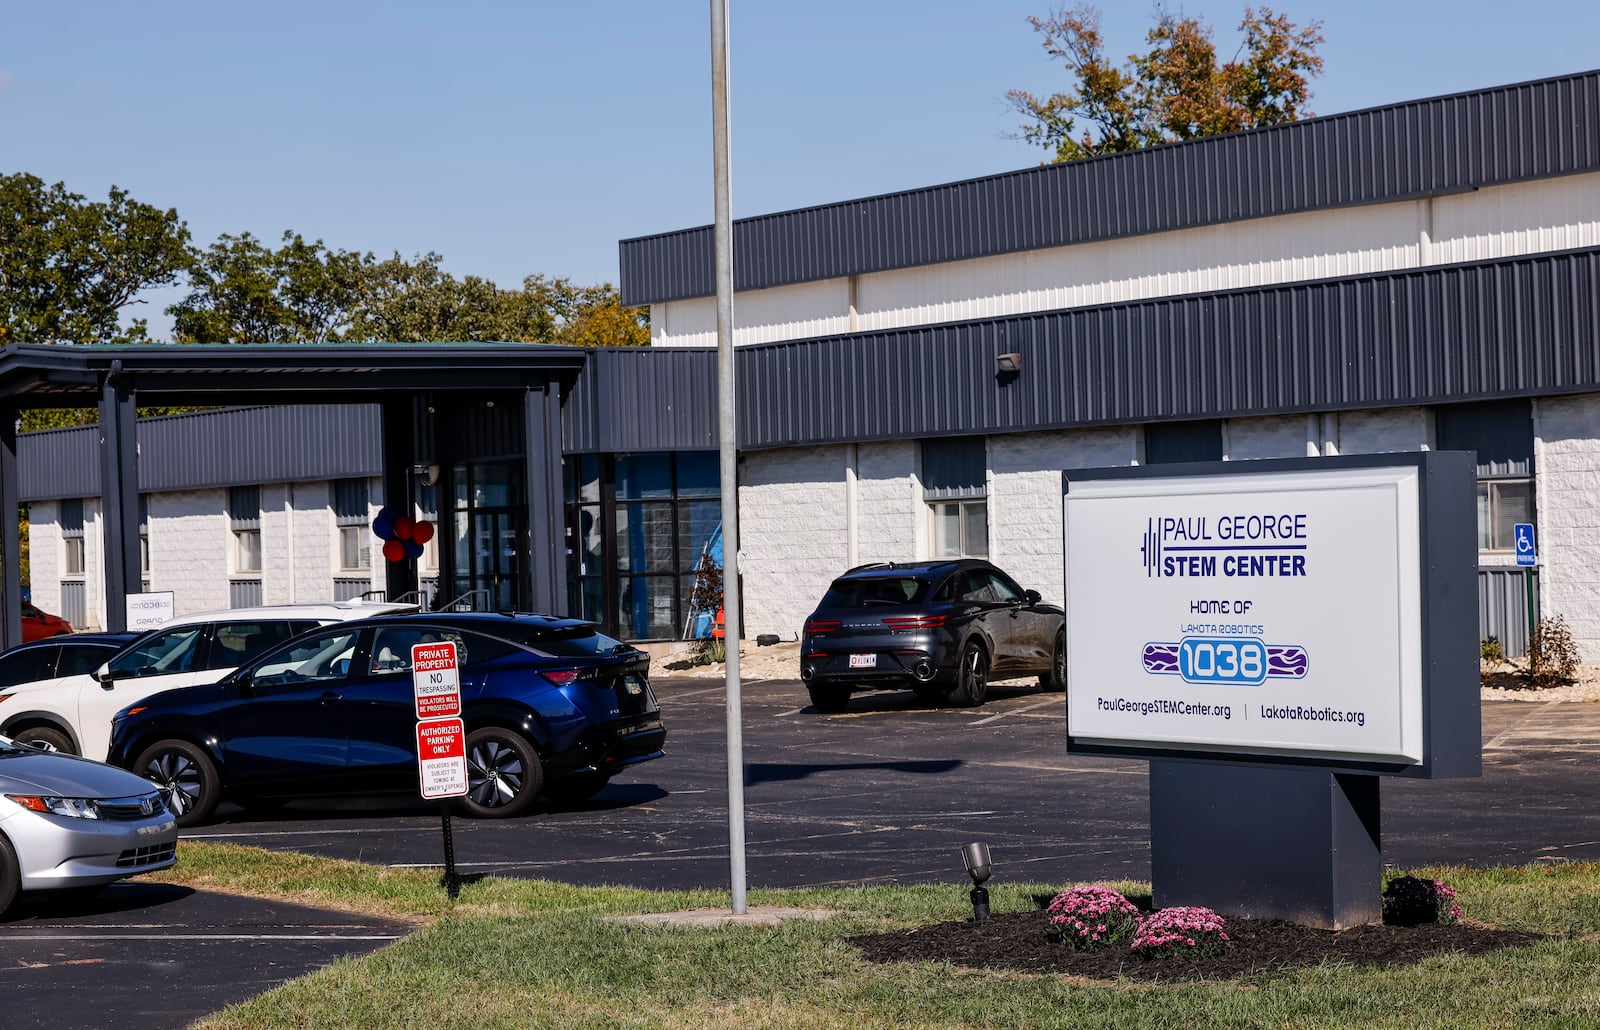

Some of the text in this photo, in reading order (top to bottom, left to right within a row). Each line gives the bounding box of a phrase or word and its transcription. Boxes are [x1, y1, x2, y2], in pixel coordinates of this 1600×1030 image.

[1163, 514, 1307, 541] PAUL GEORGE
[1163, 555, 1307, 577] STEM CENTER
[1190, 600, 1253, 614] HOME OF
[1181, 624, 1264, 635] LAKOTA ROBOTICS
[419, 649, 449, 660] PRIVATE
[415, 658, 455, 670] PROPERTY
[1183, 643, 1262, 679] 1038
[430, 672, 443, 684] NO
[419, 684, 455, 693] TRESPASSING
[419, 695, 457, 705] VIOLATORS WILL
[427, 703, 458, 712] PROSECUTED
[1097, 697, 1365, 727] PaulGeorgeSTEMCenter.org LakotaRobotics.org
[421, 725, 461, 737] AUTHORIZED
[427, 735, 455, 746] PARKING
[432, 745, 450, 754] ONLY
